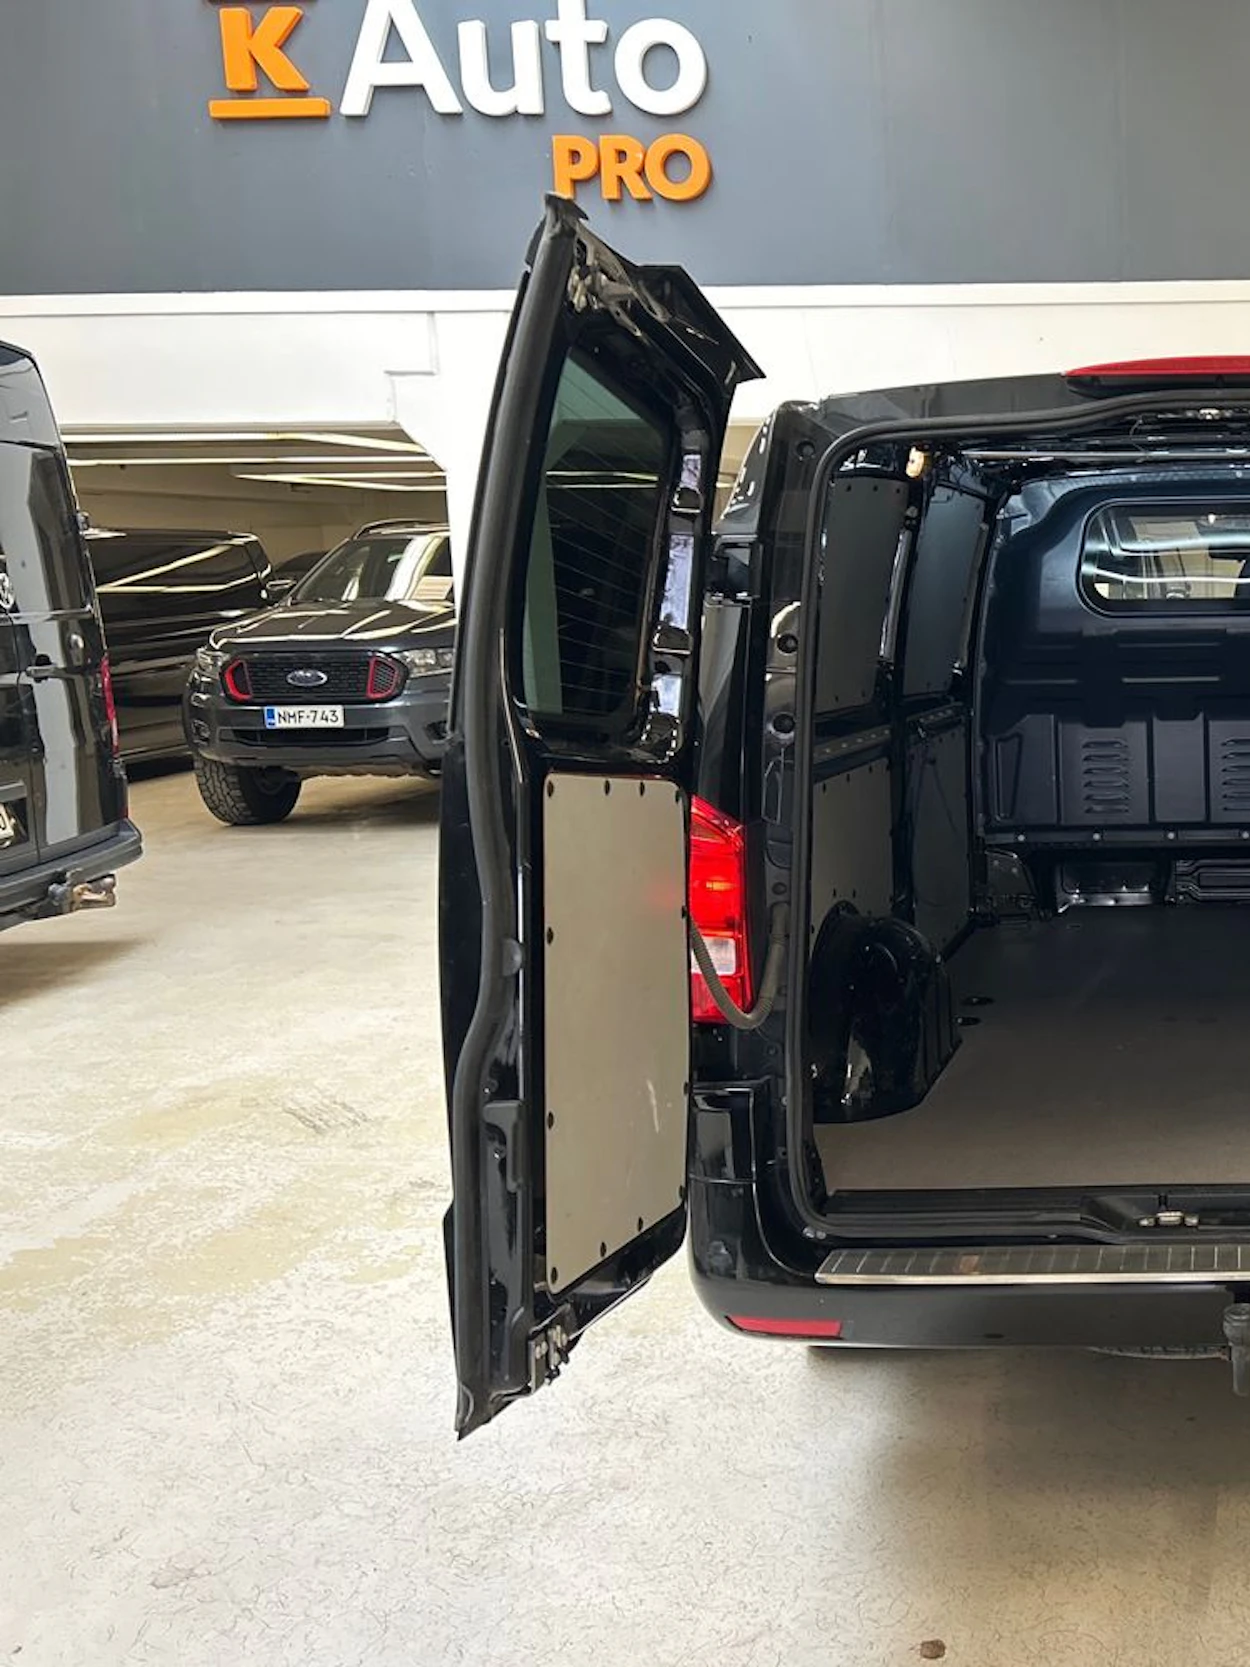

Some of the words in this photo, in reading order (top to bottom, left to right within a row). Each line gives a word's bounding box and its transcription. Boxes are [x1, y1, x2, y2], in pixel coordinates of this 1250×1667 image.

[219, 6, 310, 91] K
[340, 0, 708, 116] Auto
[552, 133, 712, 200] PRO
[278, 709, 339, 723] NMF-743
